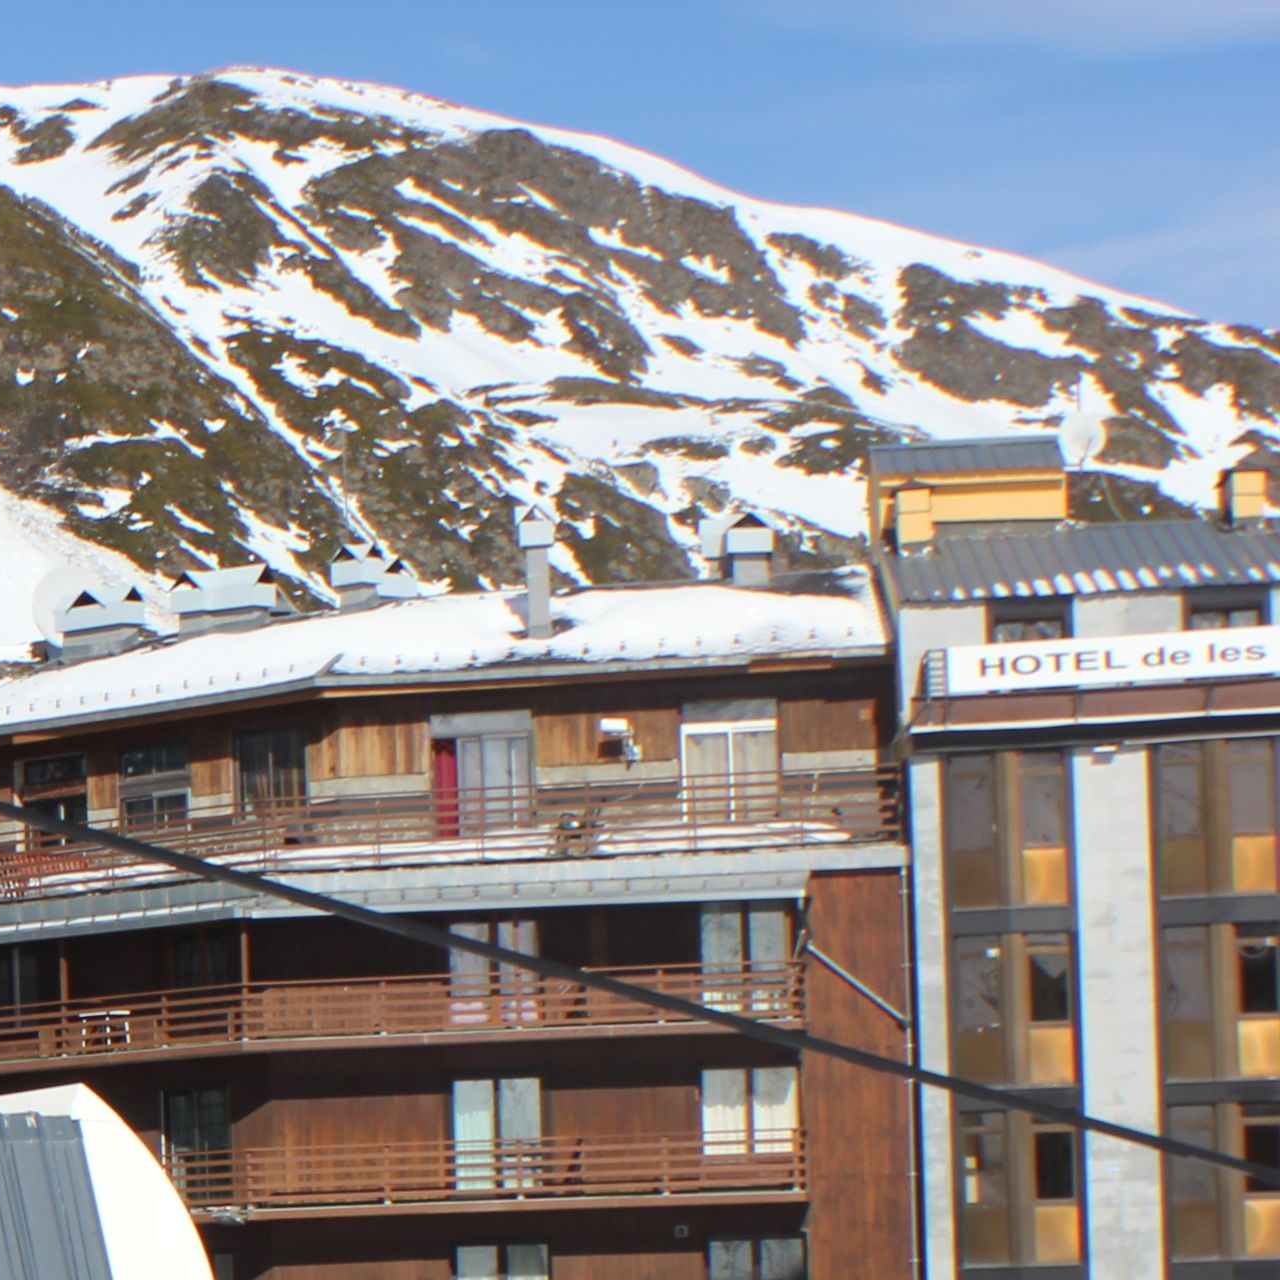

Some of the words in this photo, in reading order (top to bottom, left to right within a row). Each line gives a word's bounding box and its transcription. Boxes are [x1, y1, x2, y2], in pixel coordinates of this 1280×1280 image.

[978, 649, 1128, 678] HOTEL
[1142, 646, 1192, 668] de
[1207, 643, 1268, 664] les
